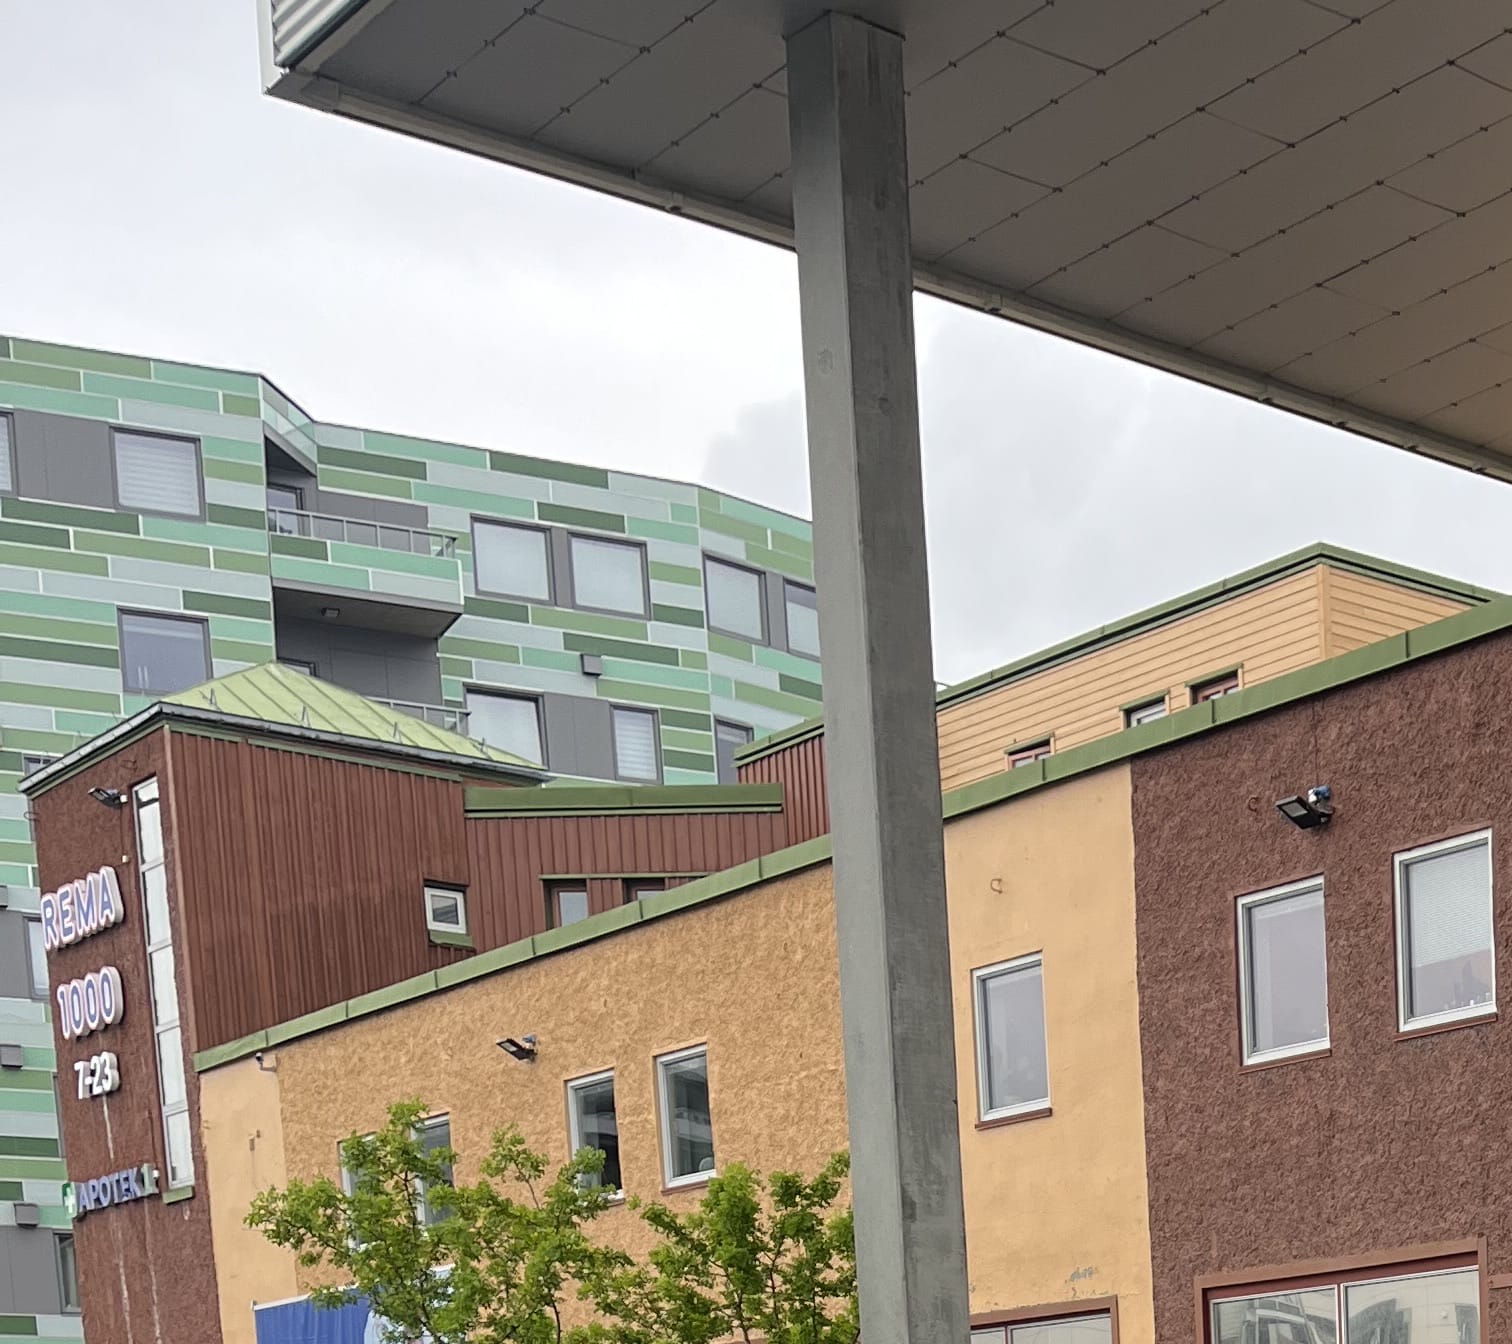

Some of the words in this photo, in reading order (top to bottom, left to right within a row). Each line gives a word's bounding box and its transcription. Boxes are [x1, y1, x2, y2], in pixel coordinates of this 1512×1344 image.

[40, 865, 124, 951] REMA
[57, 966, 123, 1040] 1000
[74, 1052, 120, 1100] 7-23
[78, 1167, 142, 1213] APOTEK
